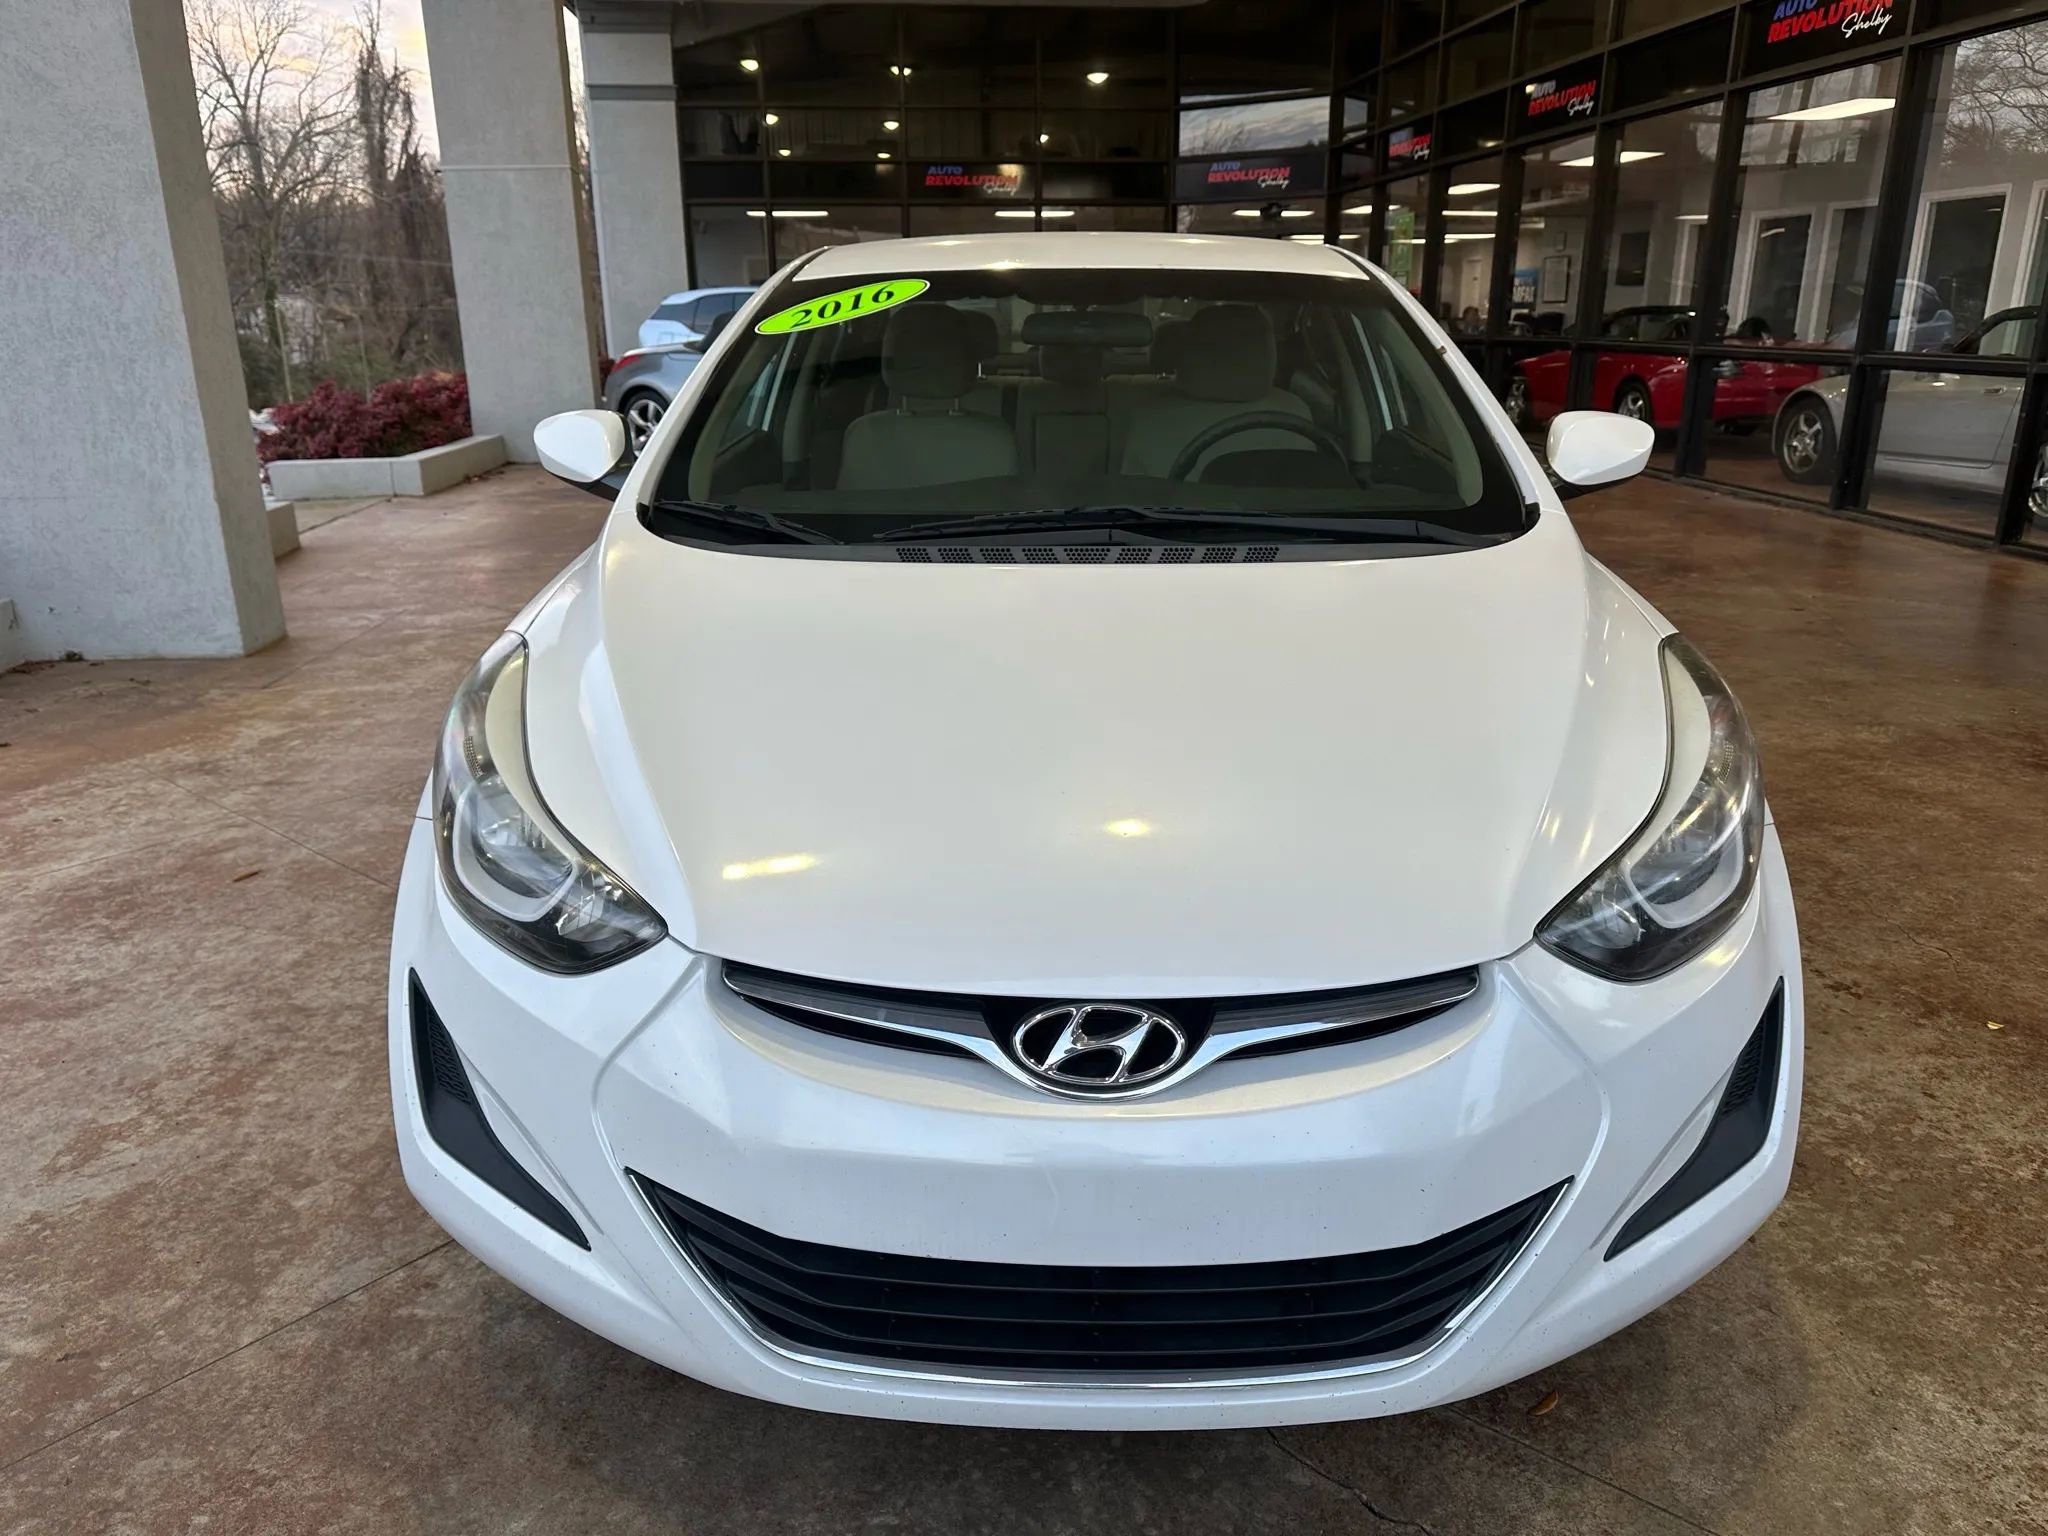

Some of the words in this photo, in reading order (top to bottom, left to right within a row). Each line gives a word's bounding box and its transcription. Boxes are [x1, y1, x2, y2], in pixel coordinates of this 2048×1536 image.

[1841, 3, 1893, 39] Shelby
[1527, 79, 1597, 117] REVOLUTION
[928, 165, 963, 175] AUTO
[1207, 166, 1291, 184] REVOLUTION
[1209, 160, 1241, 172] AUTO
[925, 175, 1019, 187] REVOLUTION
[789, 283, 895, 329] 2016
